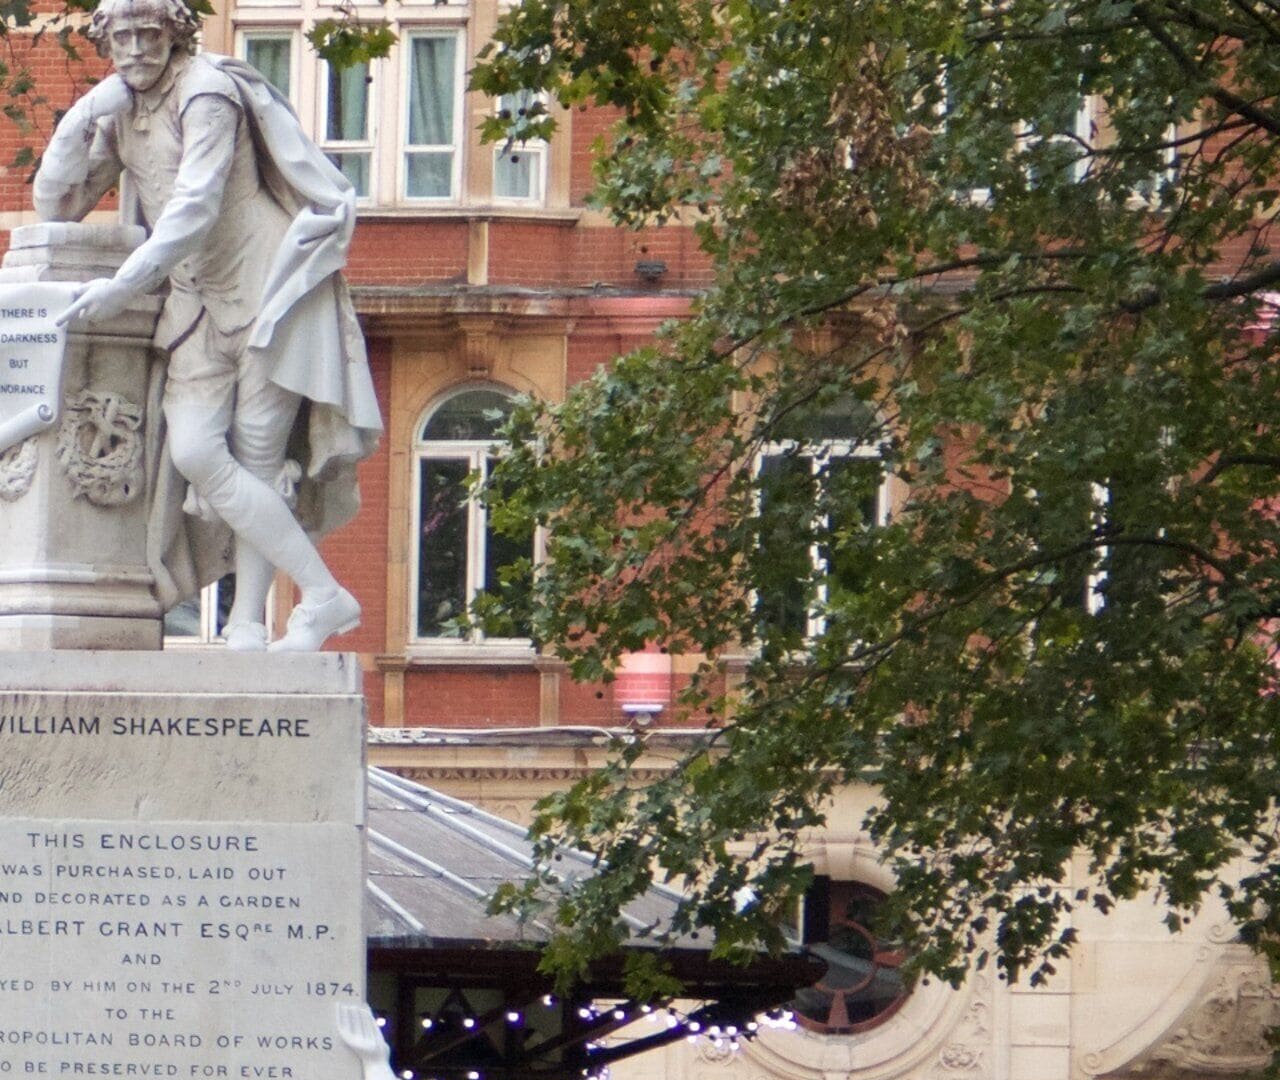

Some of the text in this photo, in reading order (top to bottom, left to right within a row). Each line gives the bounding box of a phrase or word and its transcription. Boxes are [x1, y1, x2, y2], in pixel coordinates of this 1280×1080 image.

[1, 308, 47, 318] THERE IS
[1, 333, 58, 344] DARKNESS
[9, 358, 29, 368] BUT
[113, 716, 310, 737] SHAKESPEARE
[27, 833, 258, 851] THIS ENCLOSURE
[2, 864, 287, 880] WAS PURCHASED, LAID OUT
[35, 892, 150, 907] DECORATED
[162, 895, 186, 907] AS
[198, 895, 209, 907] A
[220, 895, 300, 908] GARDEN
[98, 921, 183, 938] GRANT
[287, 924, 335, 940] M.P.
[122, 953, 161, 965] AND
[51, 981, 73, 992] BY
[83, 980, 116, 993] HIM
[127, 982, 151, 993] ON
[161, 982, 196, 994] THE
[251, 984, 293, 996] JULY
[105, 1008, 176, 1020] TO THE
[129, 1033, 202, 1048] BOARD
[216, 1035, 244, 1048] OF
[257, 1036, 333, 1050] WORKS
[24, 1061, 47, 1073] BE
[60, 1062, 178, 1075] PRESERVED
[191, 1065, 228, 1076] FOR
[241, 1066, 293, 1078] EVER
